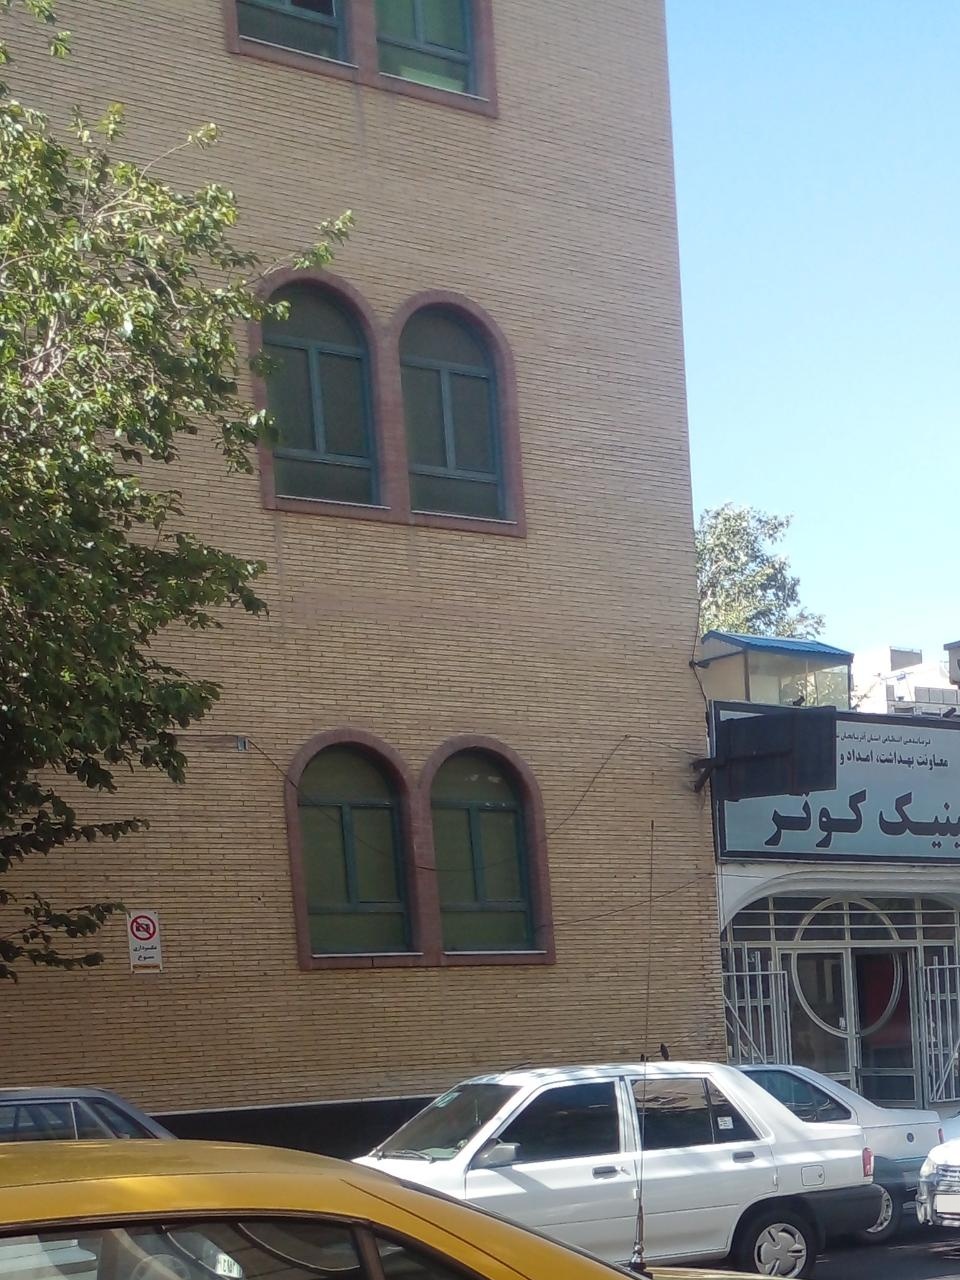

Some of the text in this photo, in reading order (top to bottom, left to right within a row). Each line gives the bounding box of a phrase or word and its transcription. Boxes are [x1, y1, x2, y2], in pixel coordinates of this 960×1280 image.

[839, 753, 845, 765] و
[846, 748, 873, 763] امداد
[916, 753, 949, 770] معاونت
[764, 788, 867, 848] کوثر
